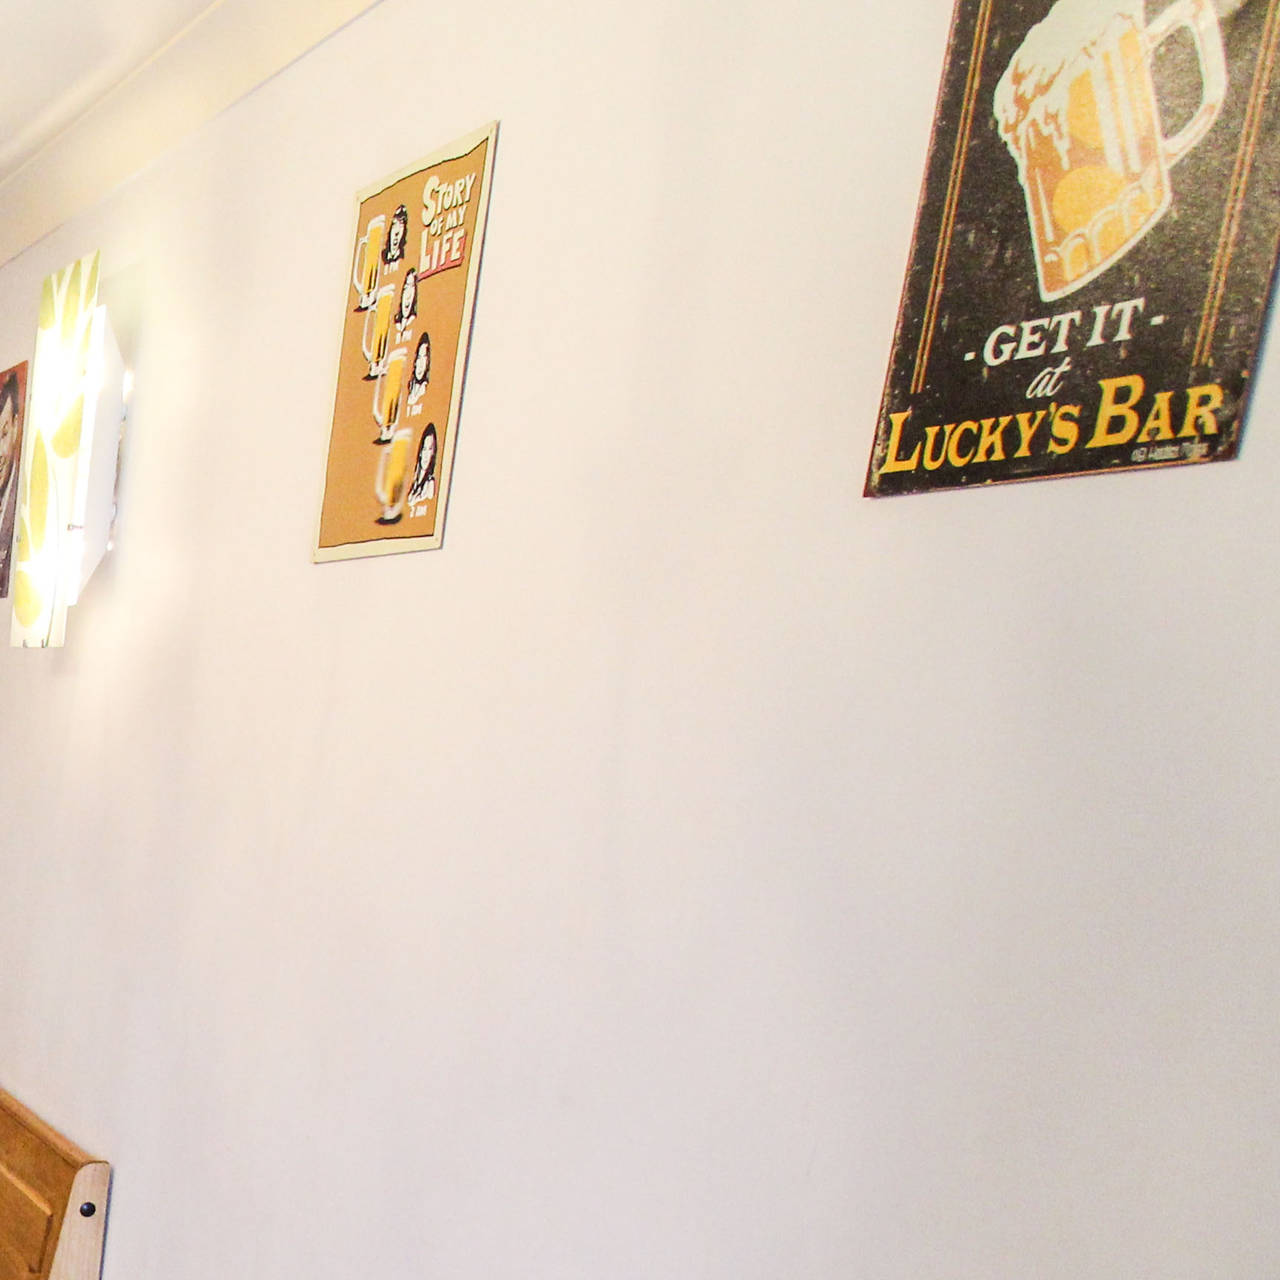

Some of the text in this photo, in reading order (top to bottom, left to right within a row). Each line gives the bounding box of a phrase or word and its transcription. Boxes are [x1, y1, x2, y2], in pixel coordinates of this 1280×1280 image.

[421, 172, 476, 227] STORY
[430, 204, 467, 236] OF MY
[419, 228, 465, 274] LIFE
[983, 298, 1146, 367] GET IT
[1025, 356, 1070, 399] at
[878, 374, 1225, 476] LUCKY'S BAR
